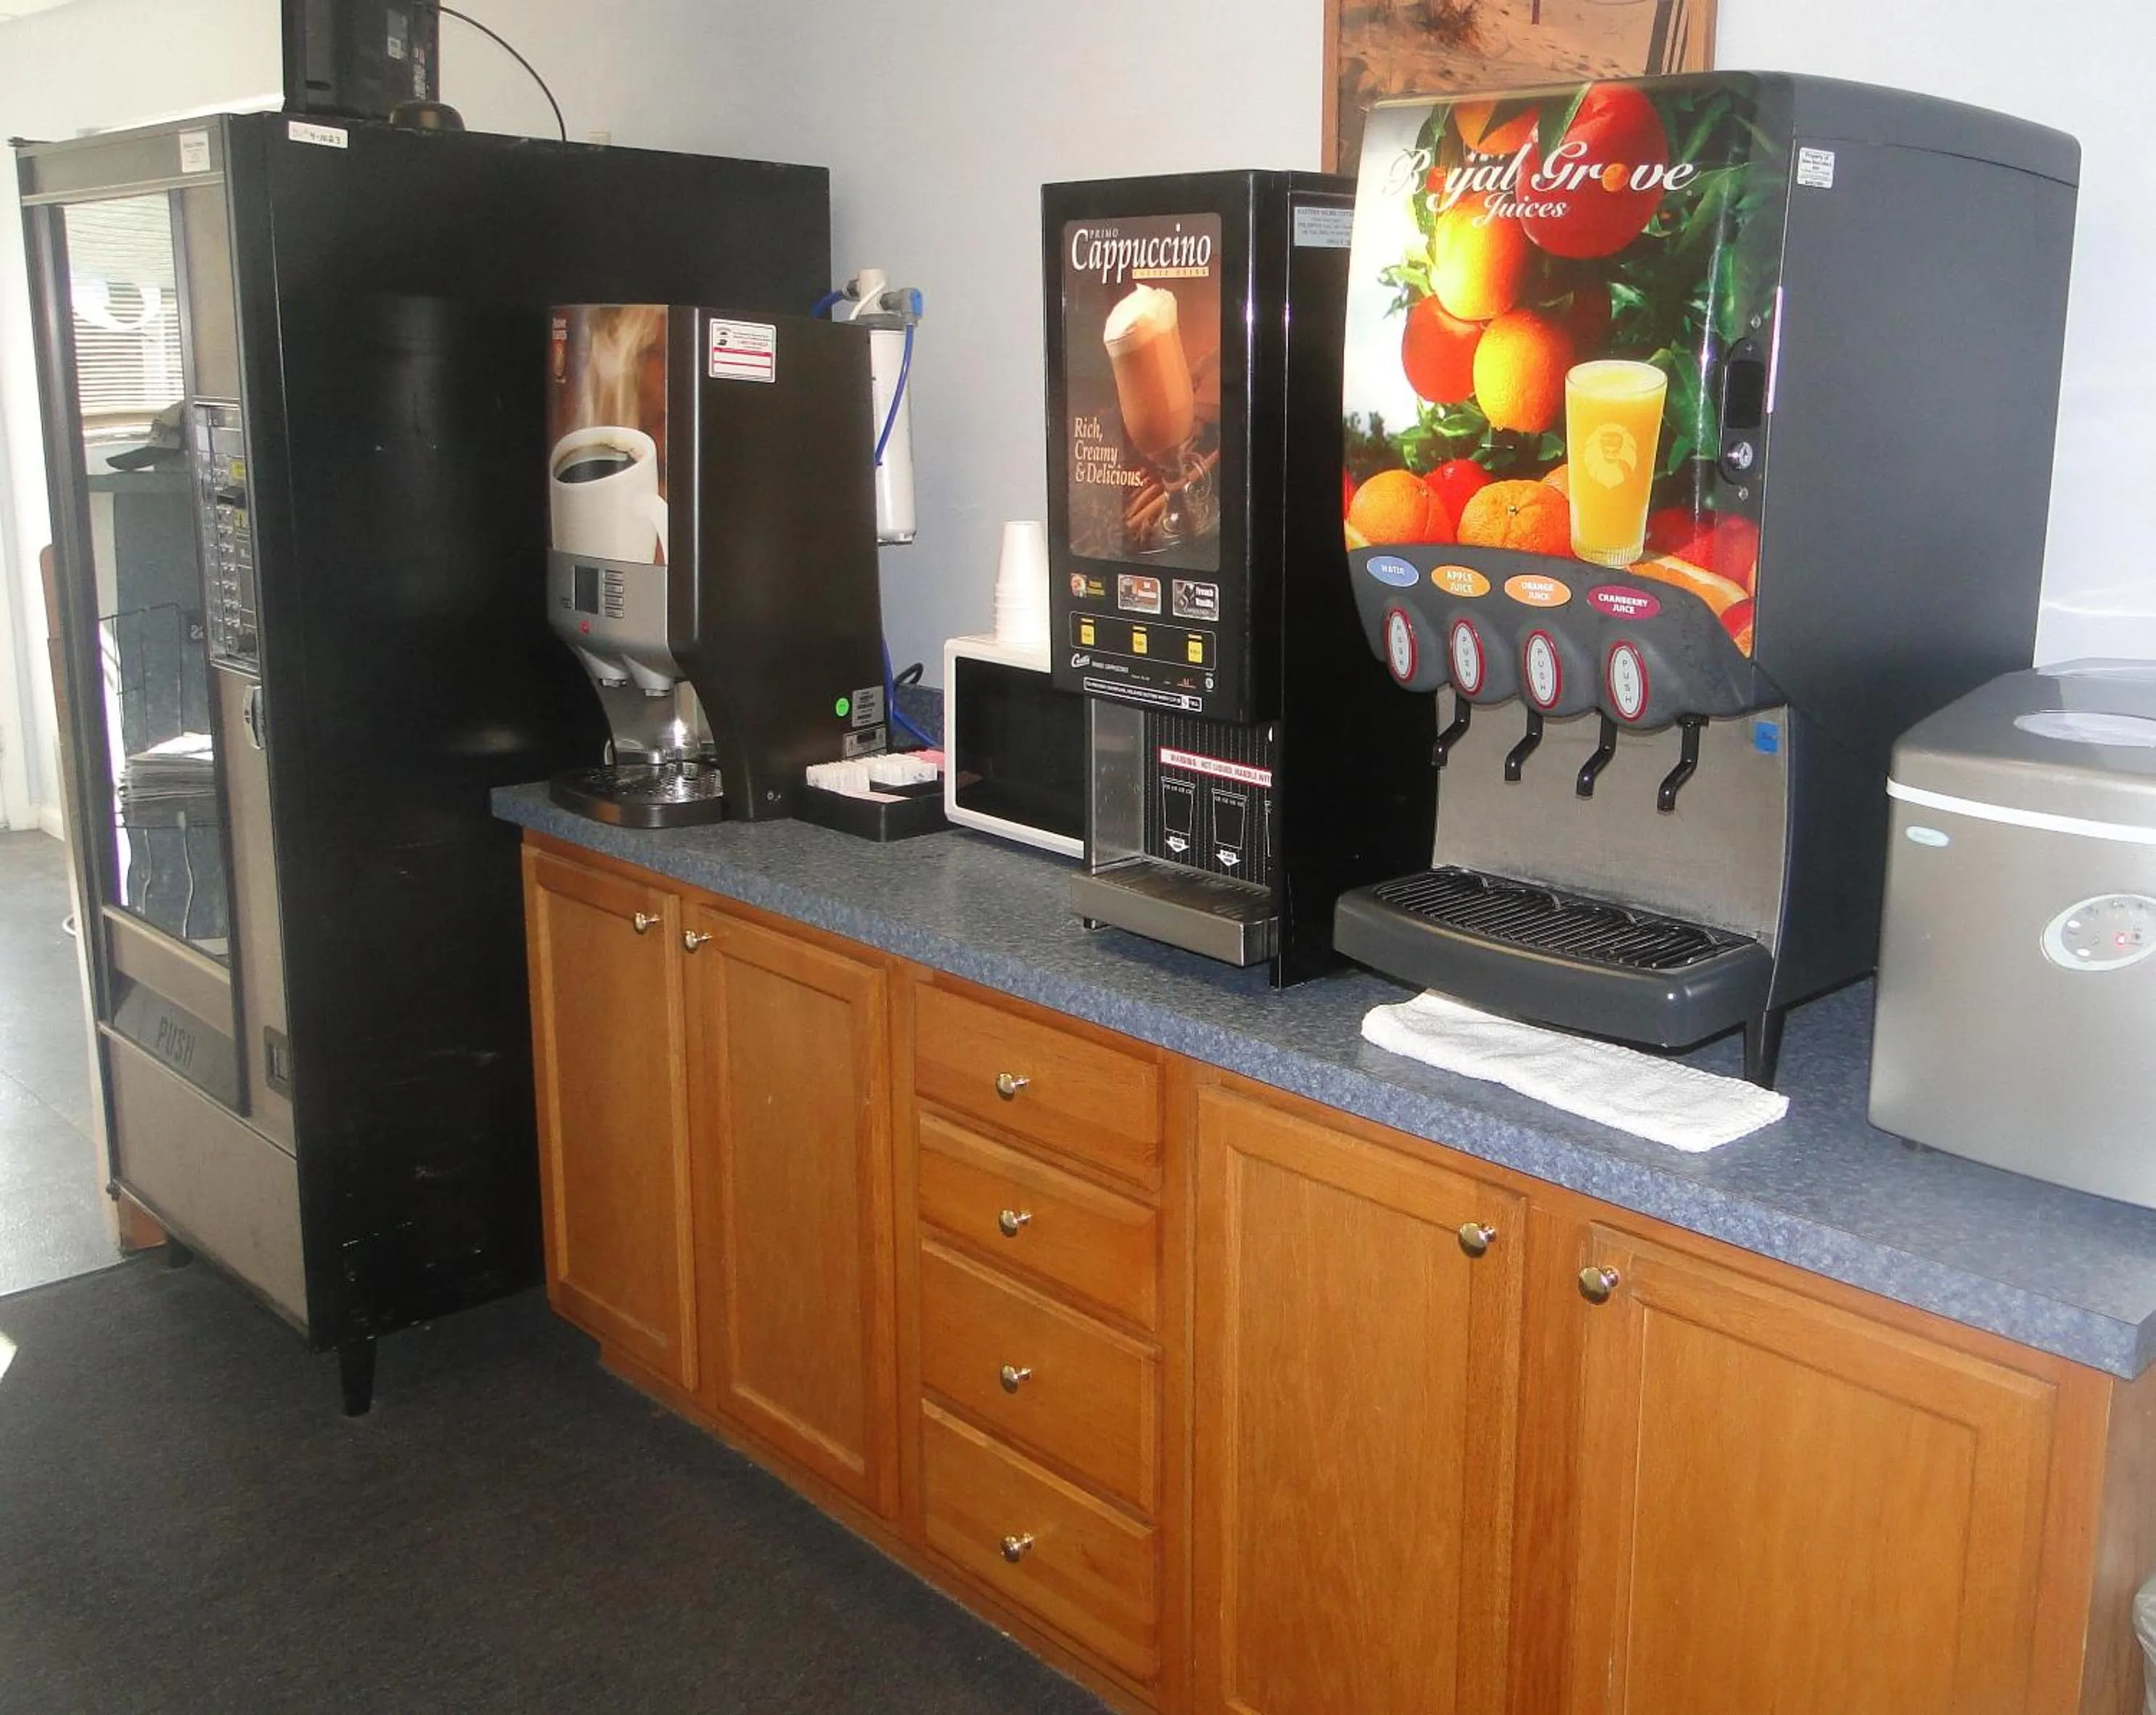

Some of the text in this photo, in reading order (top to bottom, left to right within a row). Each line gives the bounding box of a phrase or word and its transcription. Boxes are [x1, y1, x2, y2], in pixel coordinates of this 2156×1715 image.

[1381, 142, 1700, 212] Royal Grove
[1472, 191, 1568, 226] Juices
[1089, 228, 1119, 240] PRIMO
[1071, 223, 1211, 284] Cappuccino
[1074, 417, 1103, 442] Rich,
[1380, 564, 1406, 576] WATER
[1446, 570, 1473, 583] APPLE
[1450, 584, 1472, 594] JUICE
[1520, 581, 1554, 592] ORANGE
[1528, 592, 1550, 601] JUICE
[1597, 593, 1649, 607] CRANBERRY
[1612, 604, 1636, 614] JUICE
[1537, 647, 1546, 692] PUSH
[1622, 659, 1632, 704] PUSH
[157, 1015, 196, 1066] PUSH
